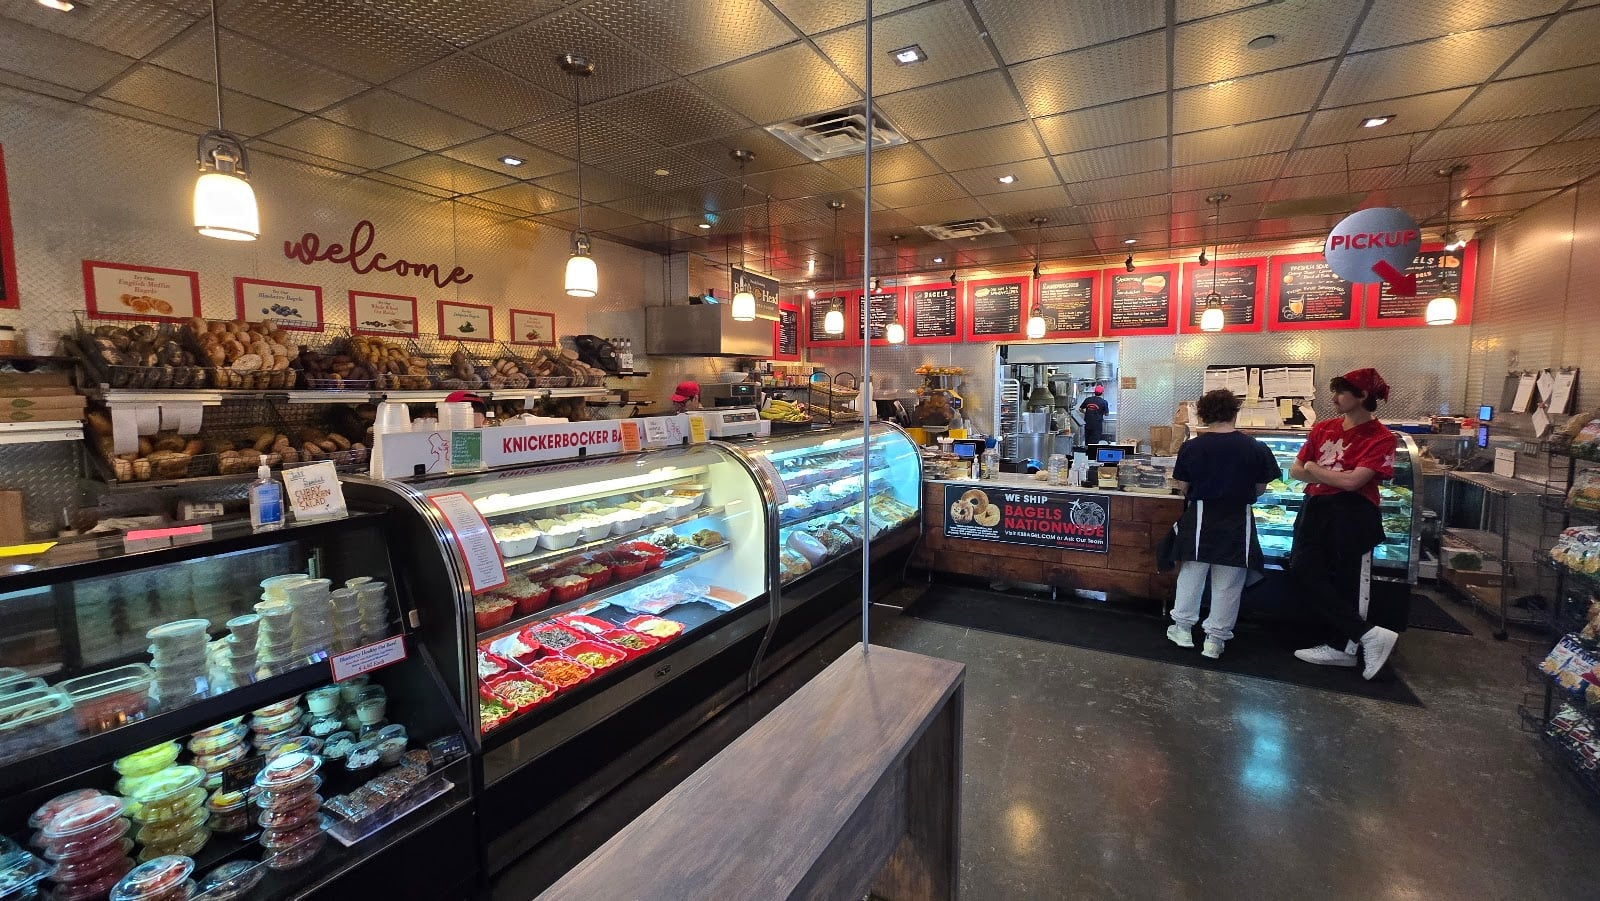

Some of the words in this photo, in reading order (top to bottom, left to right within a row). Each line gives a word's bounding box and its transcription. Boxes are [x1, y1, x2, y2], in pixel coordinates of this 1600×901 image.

[1331, 229, 1416, 251] PICKUP
[284, 220, 473, 288] welcome
[118, 278, 145, 287] English
[762, 290, 779, 305] Head
[503, 430, 608, 454] KNICKERBOCKER
[295, 485, 321, 499] CURRY
[1005, 493, 1020, 502] WE
[1023, 495, 1048, 504] SHIP
[299, 498, 326, 511] SALAD
[1005, 504, 1062, 520] BAGELS
[1004, 518, 1104, 537] NATIONWIDE
